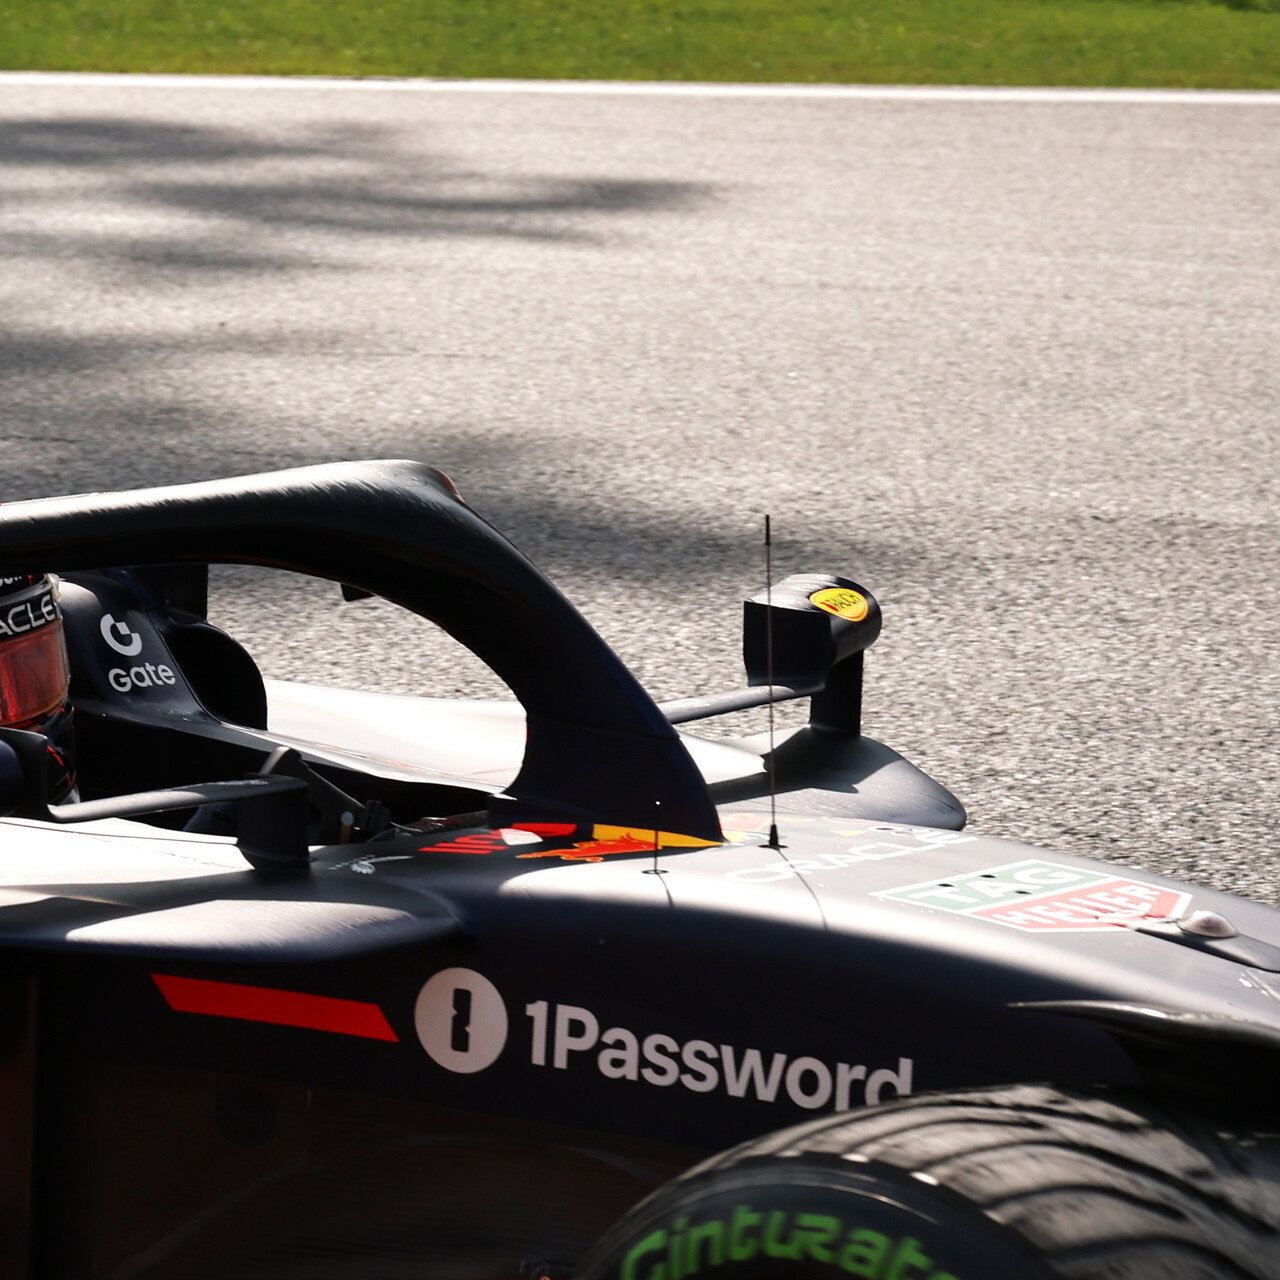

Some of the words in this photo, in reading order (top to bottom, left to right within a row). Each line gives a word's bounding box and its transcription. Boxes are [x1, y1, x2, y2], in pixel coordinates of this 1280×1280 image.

[108, 662, 176, 692] Gate
[913, 867, 1085, 904] TAG
[992, 884, 1161, 925] HEUER
[525, 1001, 913, 1111] 1Password
